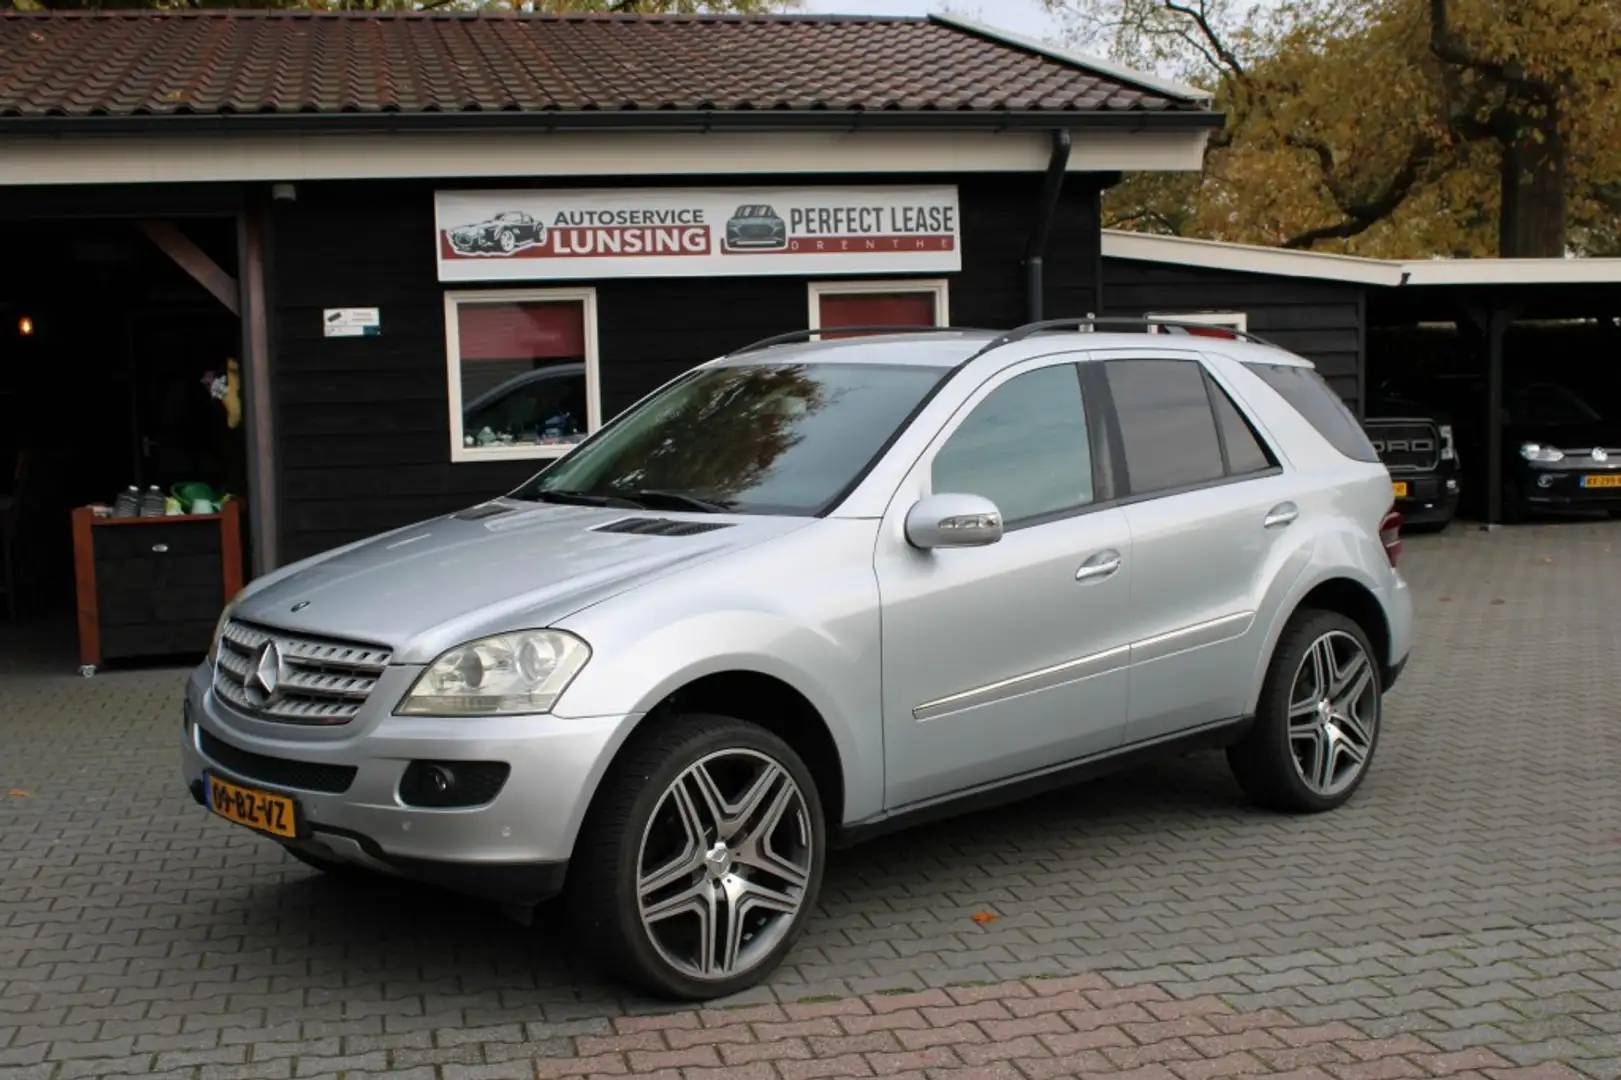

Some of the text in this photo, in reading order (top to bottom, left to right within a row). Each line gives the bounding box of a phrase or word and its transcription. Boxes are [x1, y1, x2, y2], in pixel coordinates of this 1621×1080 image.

[554, 209, 705, 226] AUTOSERVICE
[790, 206, 954, 234] PERFECT LEASE
[553, 228, 707, 255] LUNSING
